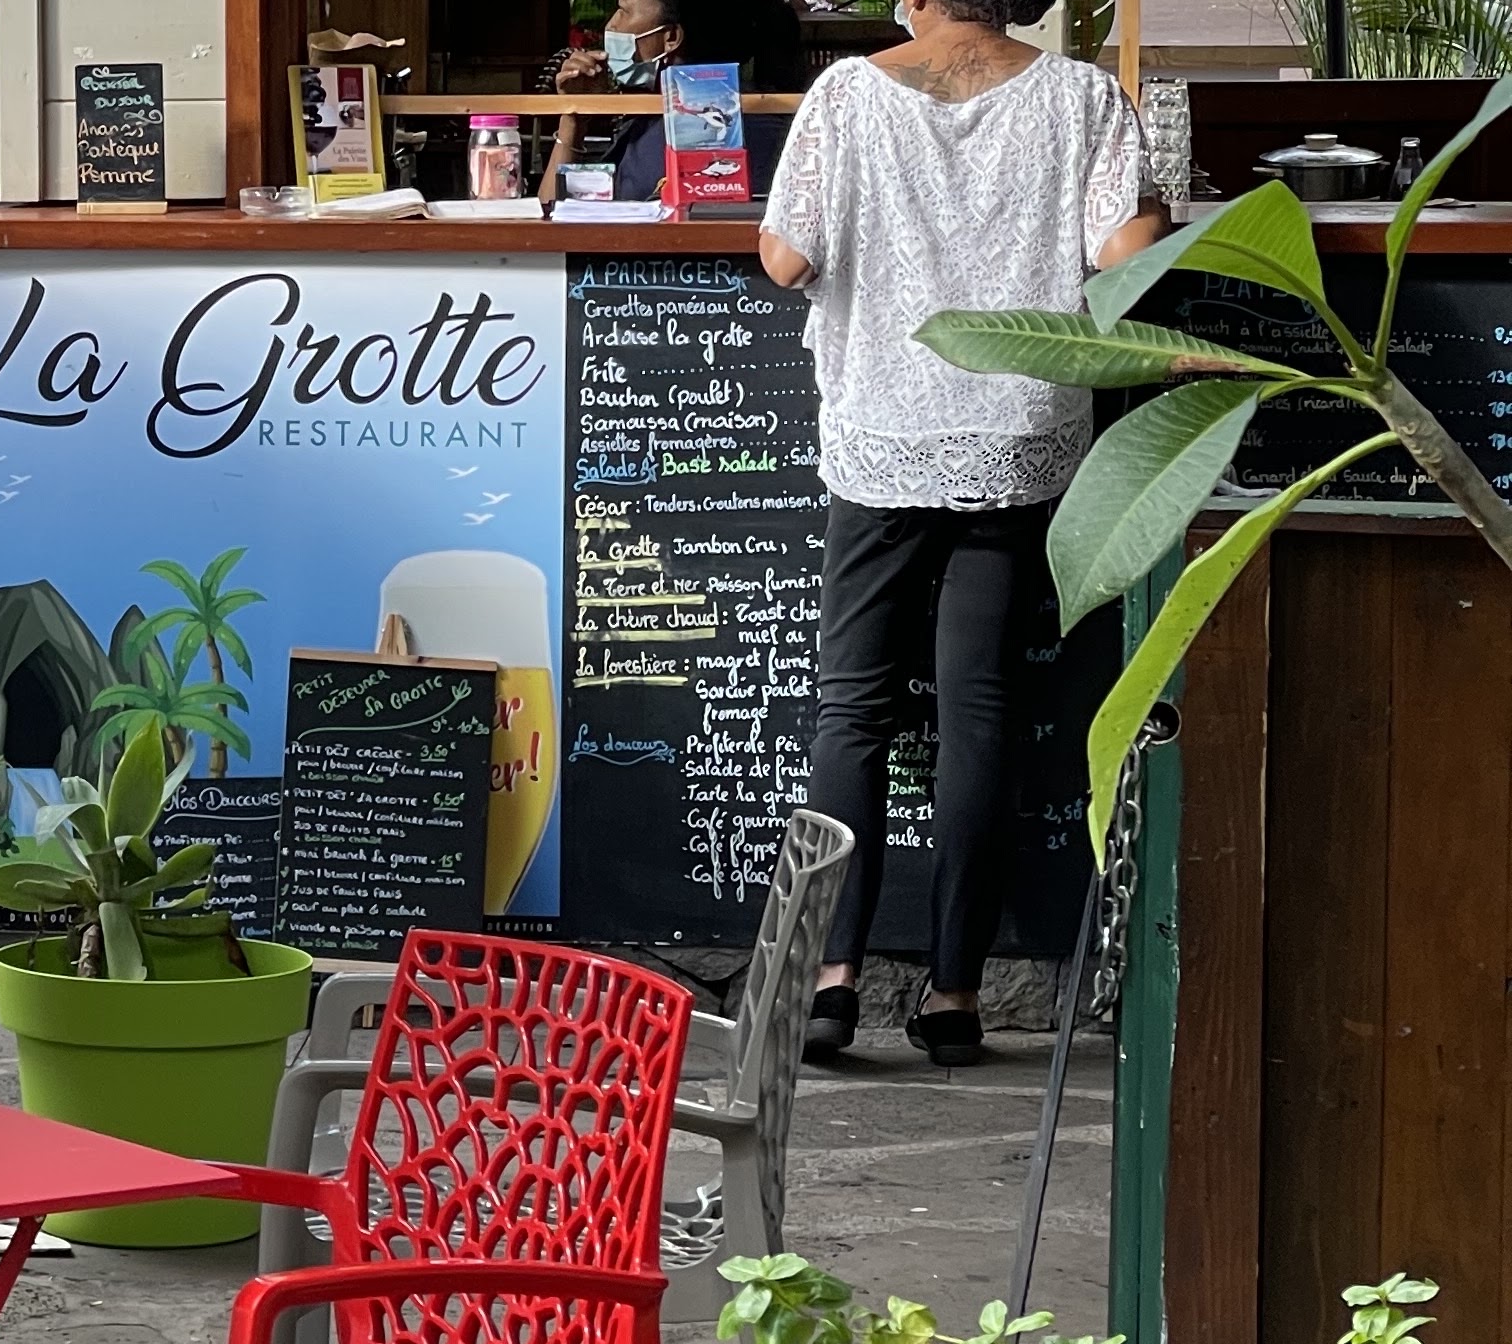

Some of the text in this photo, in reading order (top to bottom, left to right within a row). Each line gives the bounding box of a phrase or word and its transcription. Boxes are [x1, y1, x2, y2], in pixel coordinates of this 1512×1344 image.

[78, 139, 159, 165] Pastèque
[78, 163, 156, 184] Pomme
[703, 183, 745, 193] CORAIL
[605, 259, 732, 286] PARTAGER
[1204, 273, 1288, 299] PLAT
[736, 295, 774, 314] Coco
[583, 318, 753, 365] Ardoise la grotte
[146, 272, 546, 459] Grotte
[581, 356, 627, 384] Frite
[258, 420, 528, 449] RESTAURANT
[580, 411, 779, 435] Samoussa (maison)
[580, 431, 737, 458] Assiettes fromagères
[575, 453, 637, 480] Salade
[661, 452, 713, 477] Base
[1242, 466, 1295, 484] Canard
[1390, 466, 1407, 484] du
[577, 535, 600, 563] La
[673, 534, 742, 555] Jambon
[651, 572, 668, 595] et
[607, 605, 659, 629] chèvre
[739, 622, 779, 645] miel
[786, 631, 806, 644] au
[696, 647, 761, 686] magret
[703, 702, 769, 735] fromage
[687, 731, 766, 764] Profiterole
[685, 758, 743, 777] Salade
[749, 756, 771, 778] de
[887, 764, 937, 784] Tropica
[688, 783, 729, 802] Tarte
[735, 781, 757, 802] la
[888, 779, 928, 796] Dame
[916, 801, 935, 820] It
[688, 807, 727, 842] Café
[886, 826, 920, 848] oule
[689, 834, 725, 866] Café
[691, 862, 728, 899] Café
